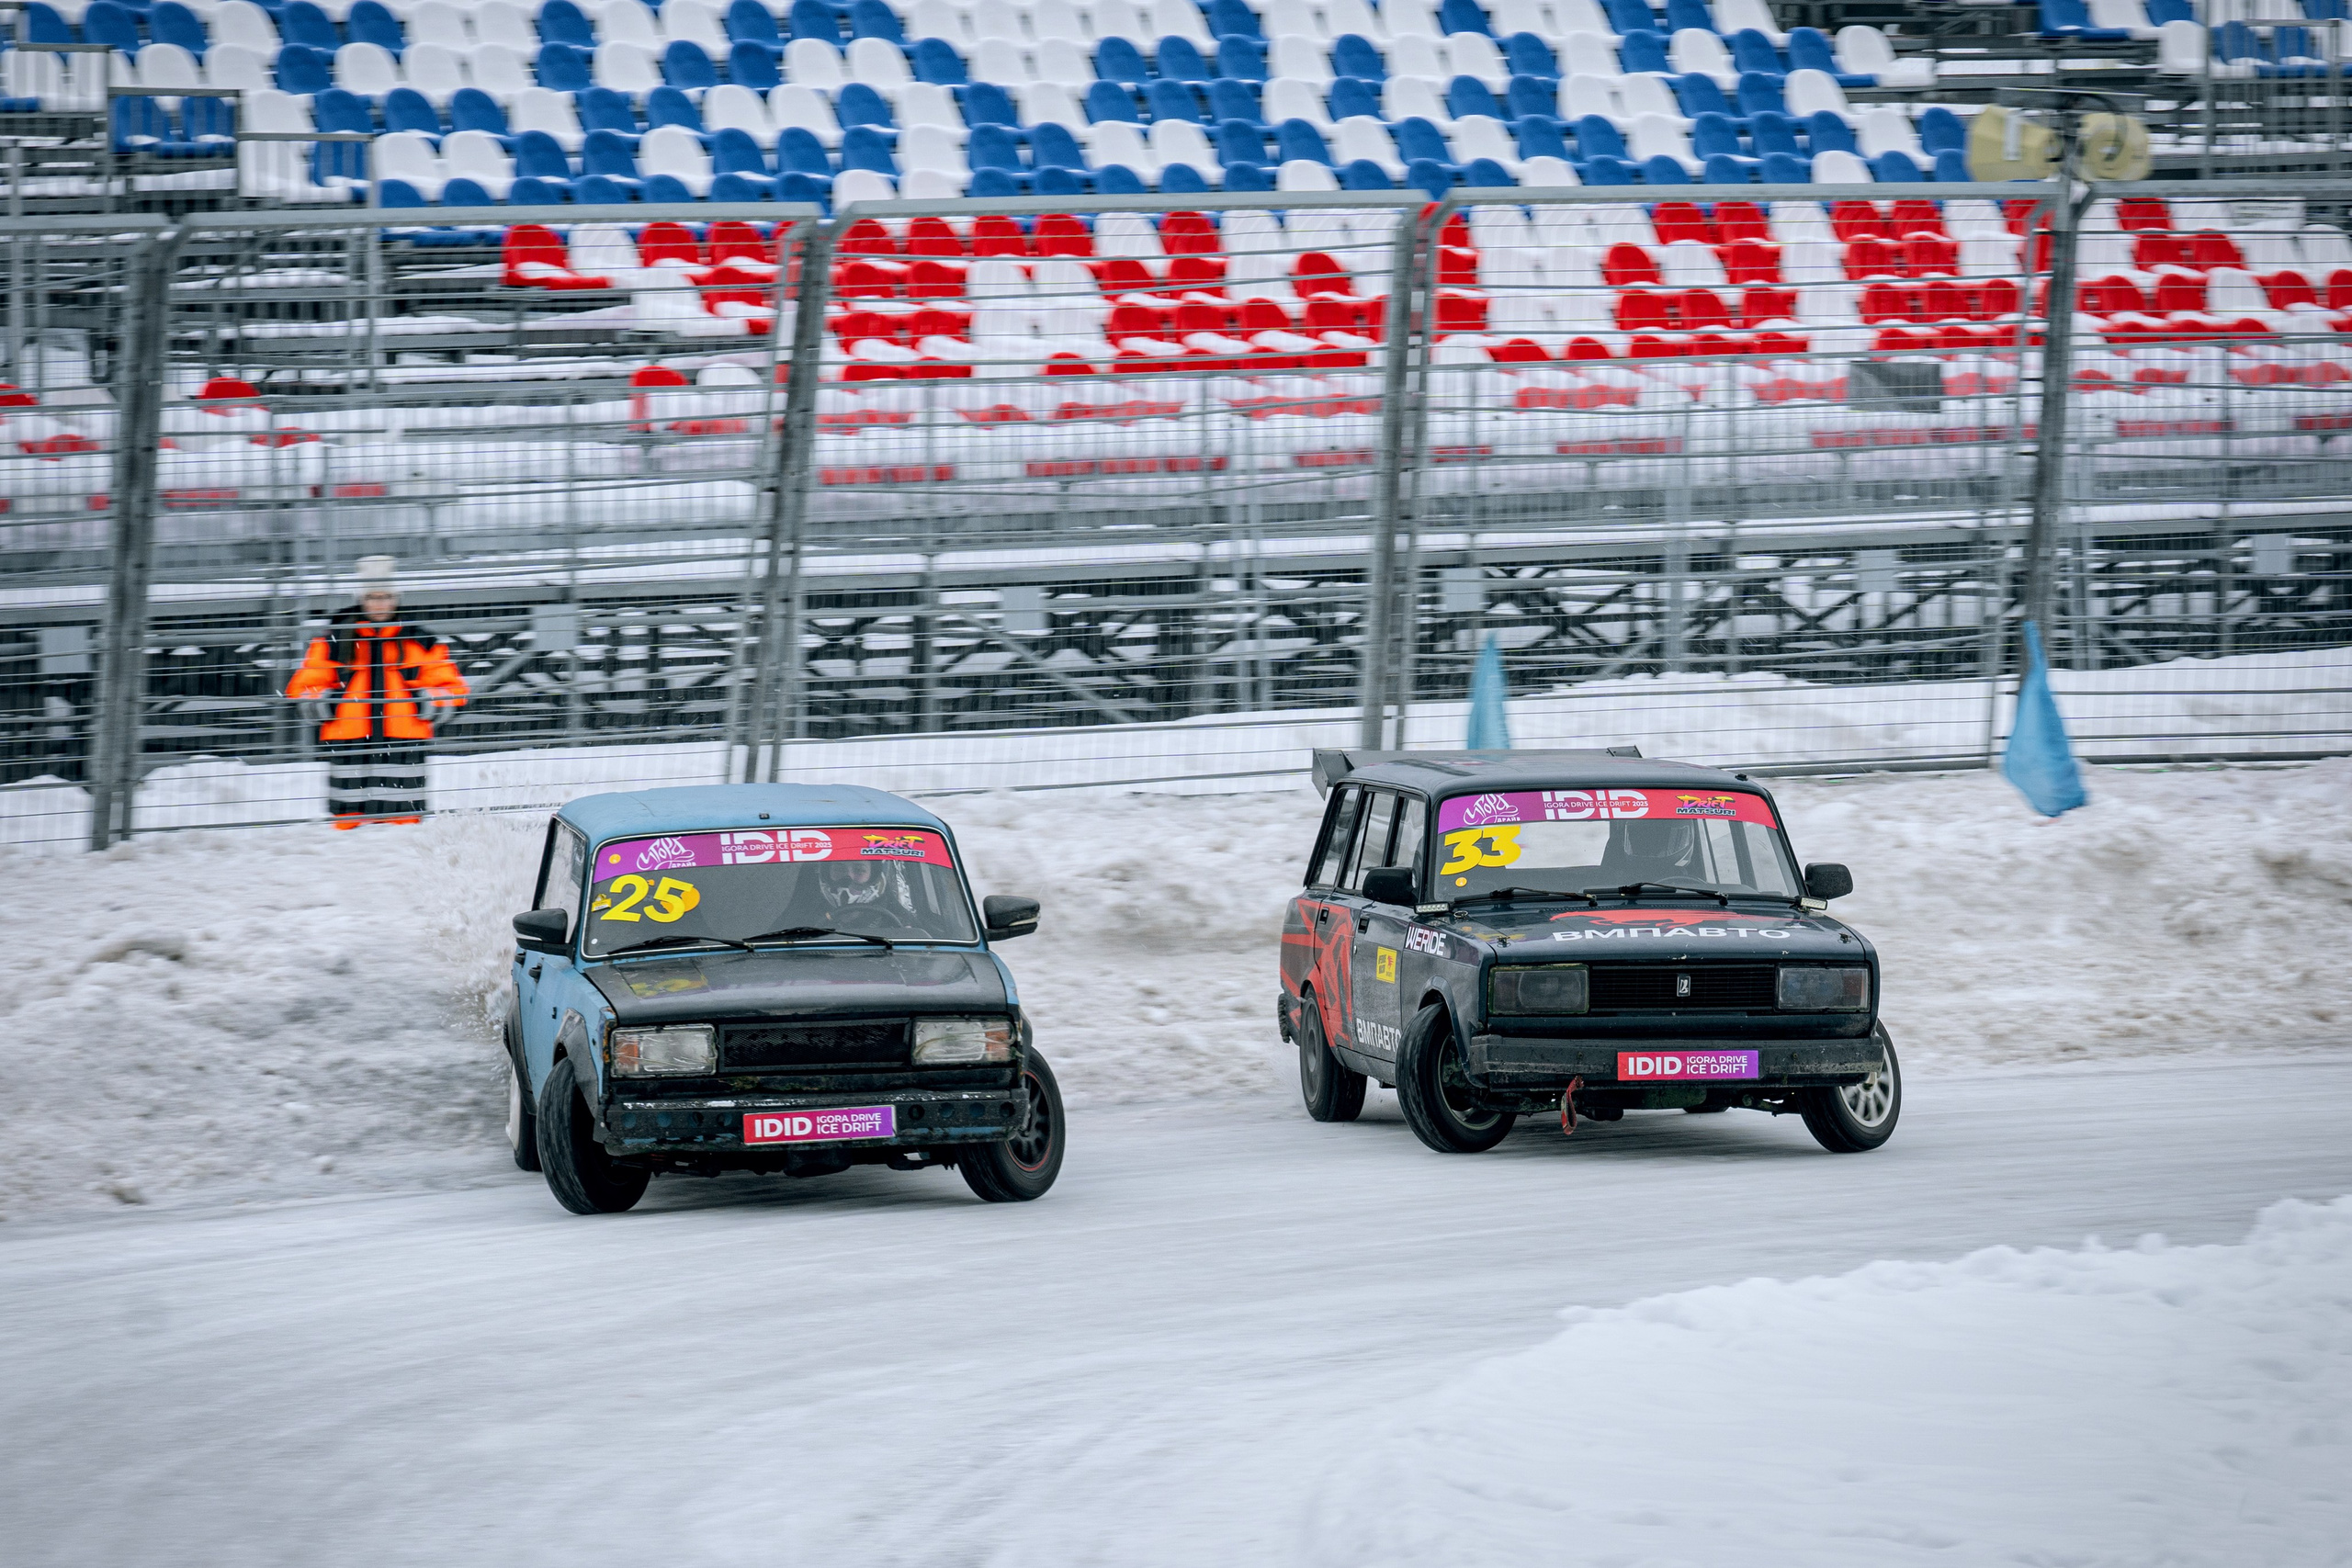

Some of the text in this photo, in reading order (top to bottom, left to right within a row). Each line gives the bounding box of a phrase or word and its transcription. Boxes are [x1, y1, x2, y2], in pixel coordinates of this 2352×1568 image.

[1542, 790, 1649, 820] IDID
[1676, 807, 1736, 817] MATSURI
[719, 829, 833, 864] IDID
[721, 844, 750, 852] IGORA
[861, 848, 925, 857] MATSURI
[1440, 825, 1521, 875] 33
[600, 874, 695, 923] 25
[1405, 926, 1447, 956] WERIDE
[1553, 927, 1791, 942] ВМПАВТО
[1628, 1056, 1682, 1076] IDID
[1686, 1055, 1747, 1065] IGORA DRIVE
[1686, 1063, 1748, 1075] ICE DRIFT
[816, 1112, 882, 1123] IGORA DRIVE
[754, 1116, 812, 1138] IDID
[817, 1121, 882, 1134] ICE DRIFT
